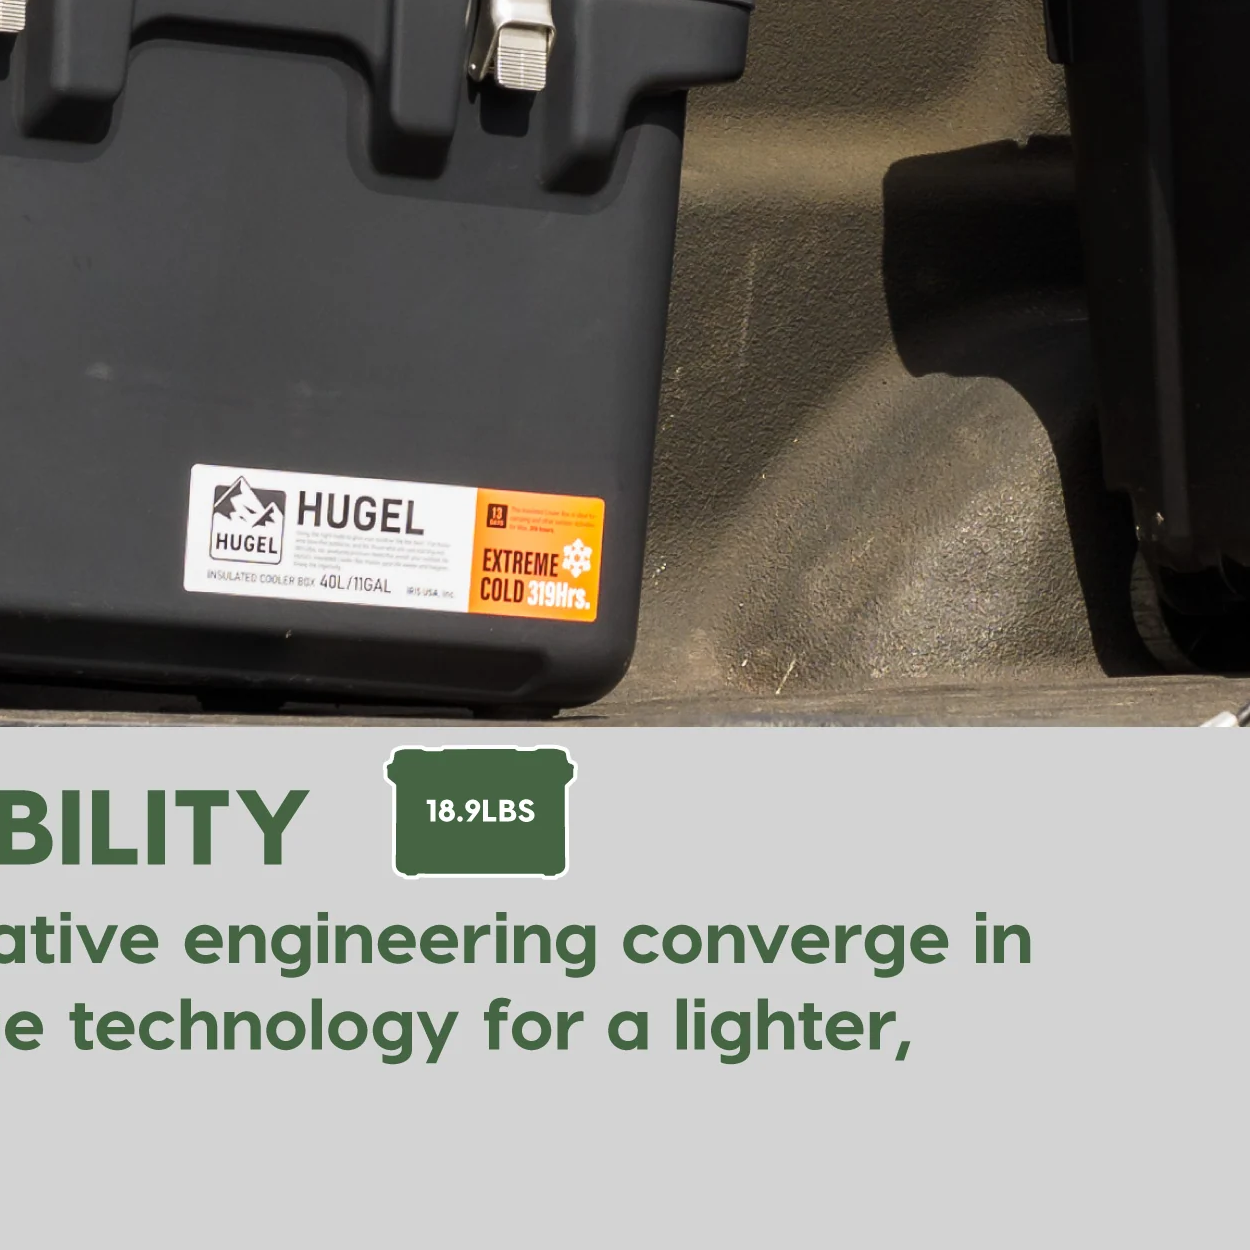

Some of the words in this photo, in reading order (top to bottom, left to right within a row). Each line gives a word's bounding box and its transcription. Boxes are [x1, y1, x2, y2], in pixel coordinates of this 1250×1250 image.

[297, 490, 424, 536] HUGEL
[492, 506, 503, 520] 13
[215, 532, 278, 555] HUGEL
[482, 547, 559, 578] EXTREME
[207, 568, 257, 583] INSULATED
[259, 573, 295, 586] COOLER
[297, 577, 316, 588] BOX
[319, 572, 392, 595] 40L/11GAL
[480, 576, 525, 603] COLD
[527, 580, 591, 610] 319Hrs.
